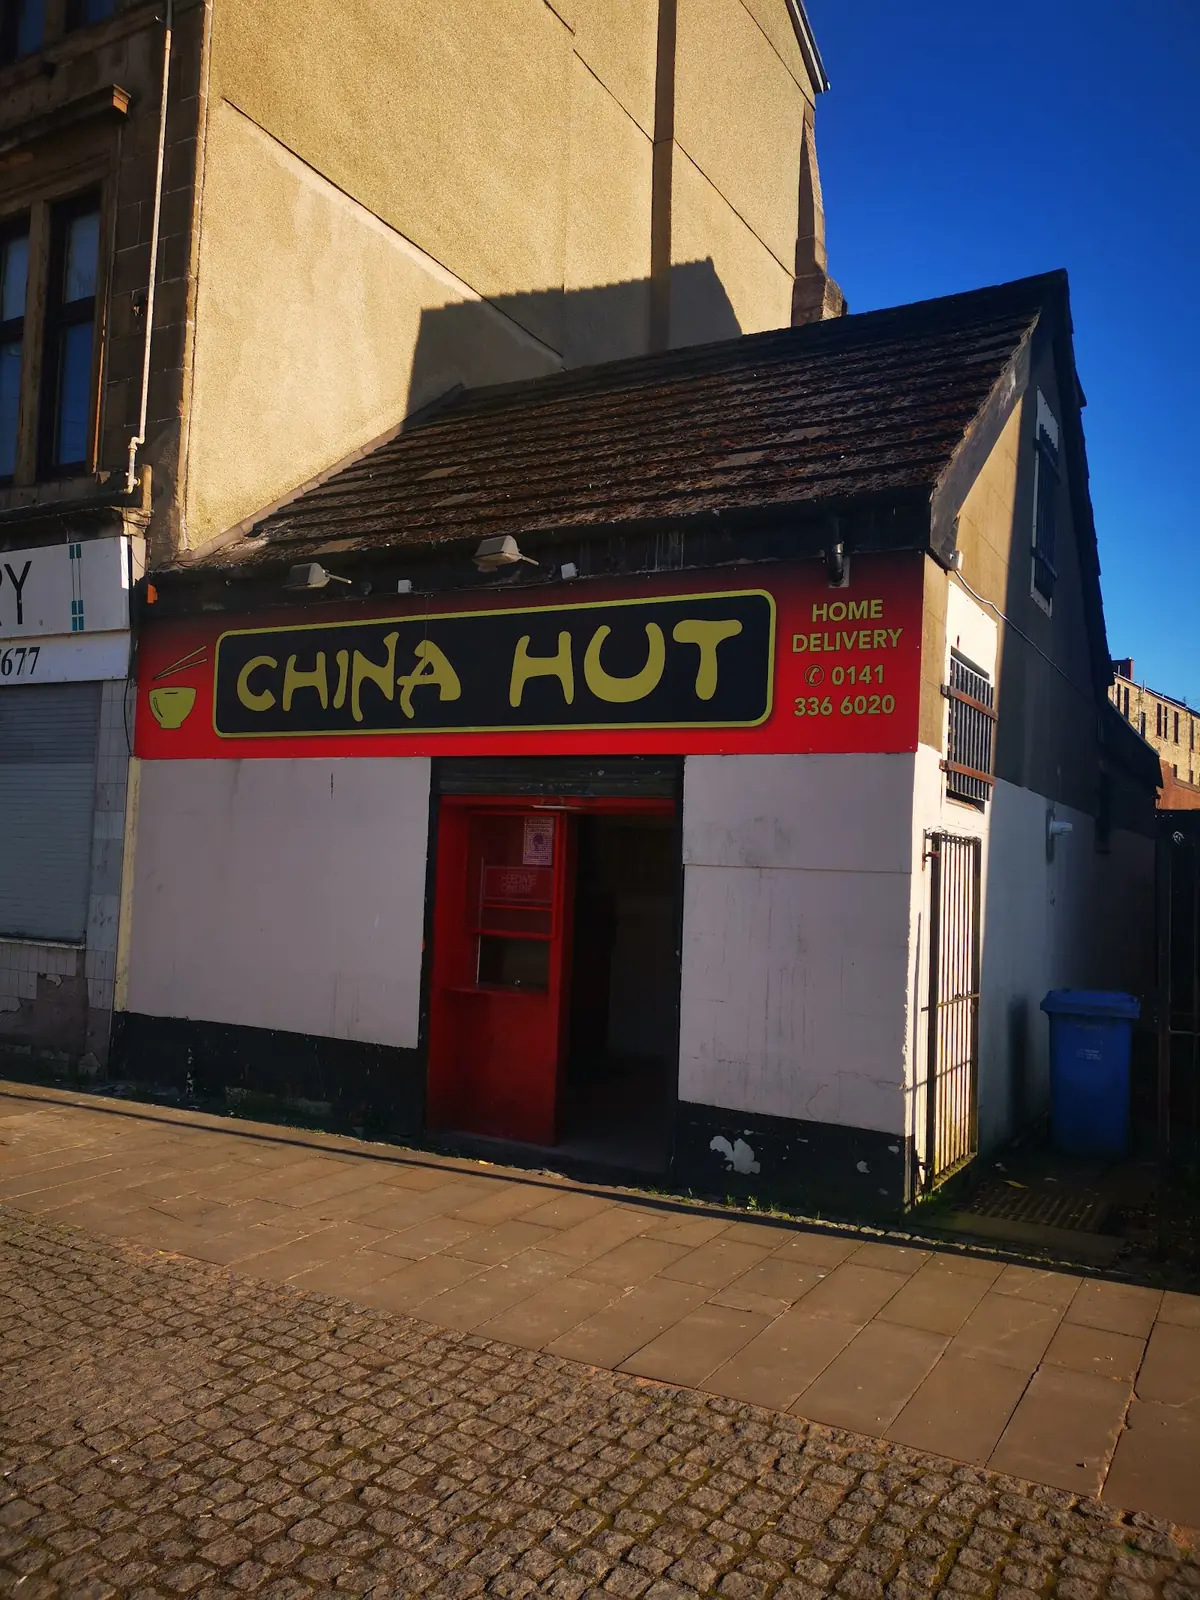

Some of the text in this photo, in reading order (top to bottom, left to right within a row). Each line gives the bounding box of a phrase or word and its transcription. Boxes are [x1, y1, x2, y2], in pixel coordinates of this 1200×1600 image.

[0, 560, 32, 626] Y
[812, 599, 884, 622] HOME
[792, 628, 904, 653] DELIVERY
[0, 646, 41, 676] 677
[236, 619, 743, 722] CHINA HUT
[831, 664, 884, 685] 0141
[794, 694, 896, 716] 336 6020
